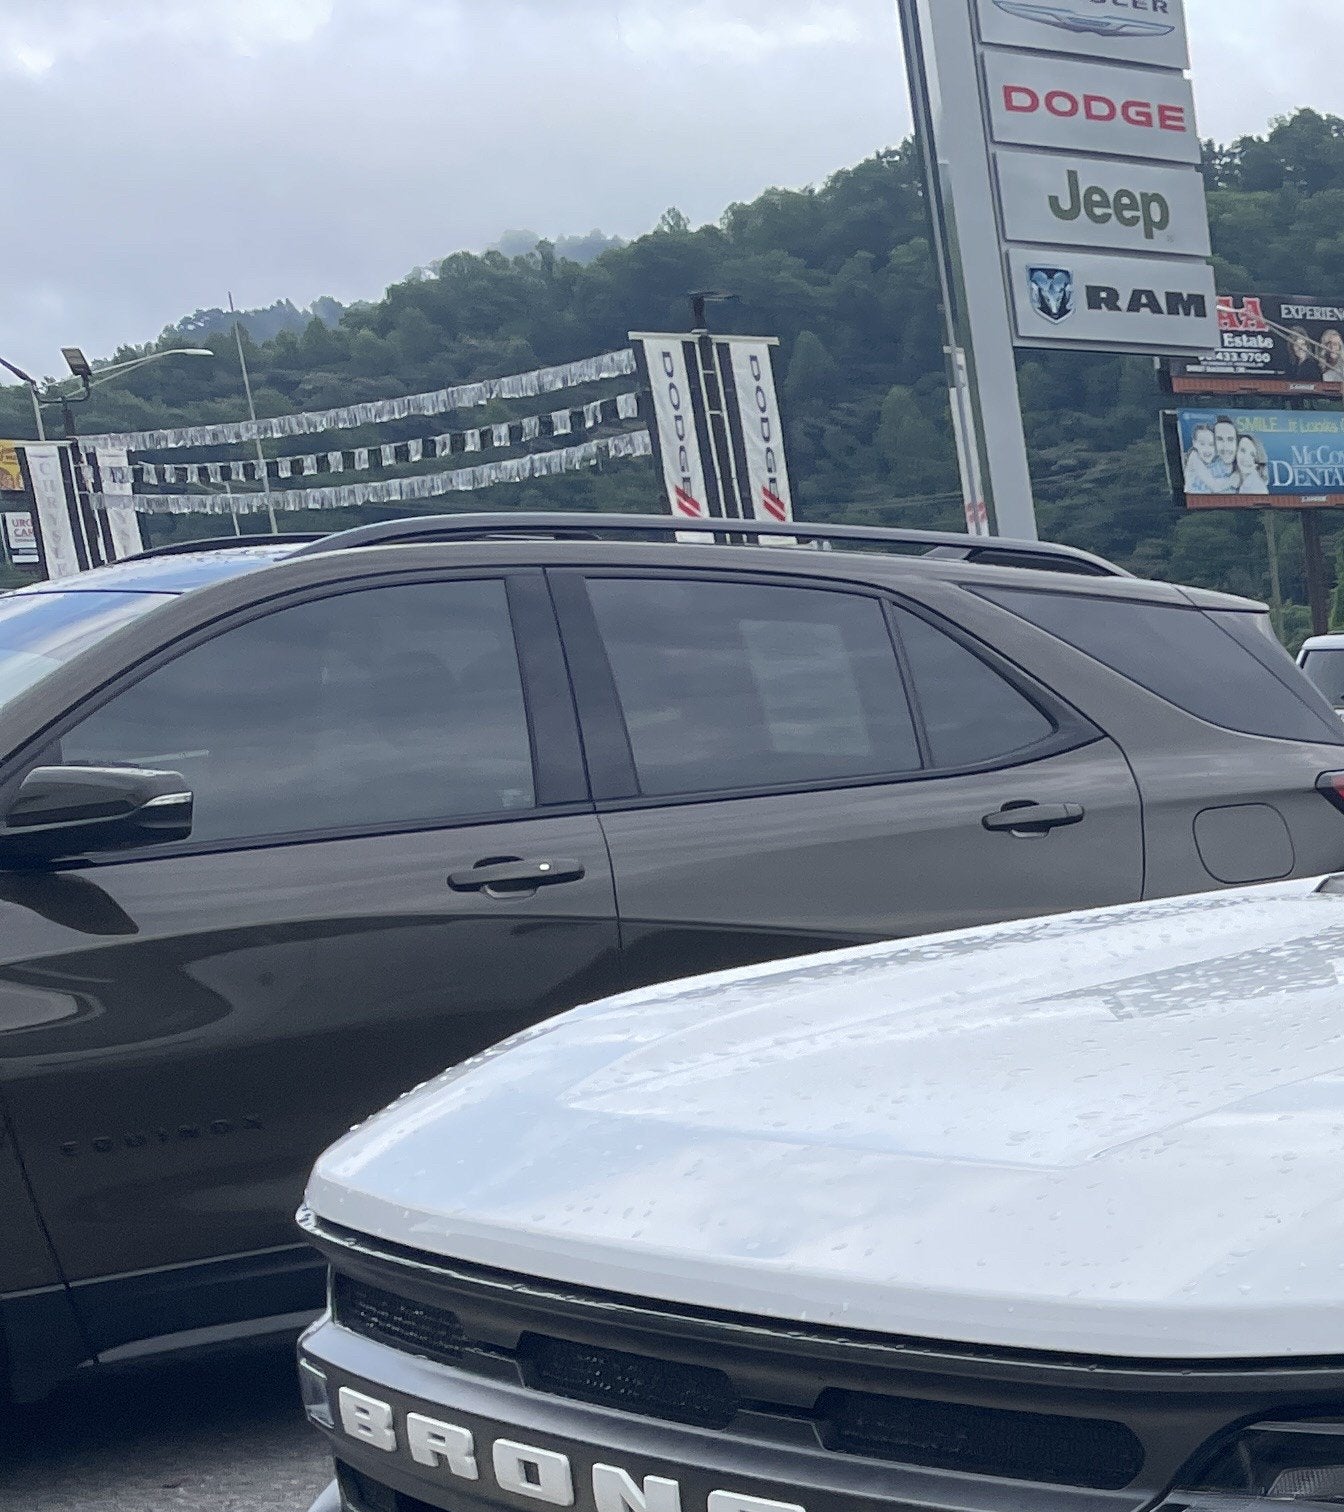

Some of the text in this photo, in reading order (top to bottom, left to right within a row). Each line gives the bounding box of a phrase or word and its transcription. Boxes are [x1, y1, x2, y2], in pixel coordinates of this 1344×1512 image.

[1002, 85, 1187, 132] DODGE
[1048, 169, 1170, 239] Jeep
[1085, 284, 1207, 318] RAM
[1223, 333, 1274, 349] Estate
[661, 351, 692, 499] DODGE
[750, 354, 780, 499] DODGE
[59, 1111, 264, 1157] EQUINOX
